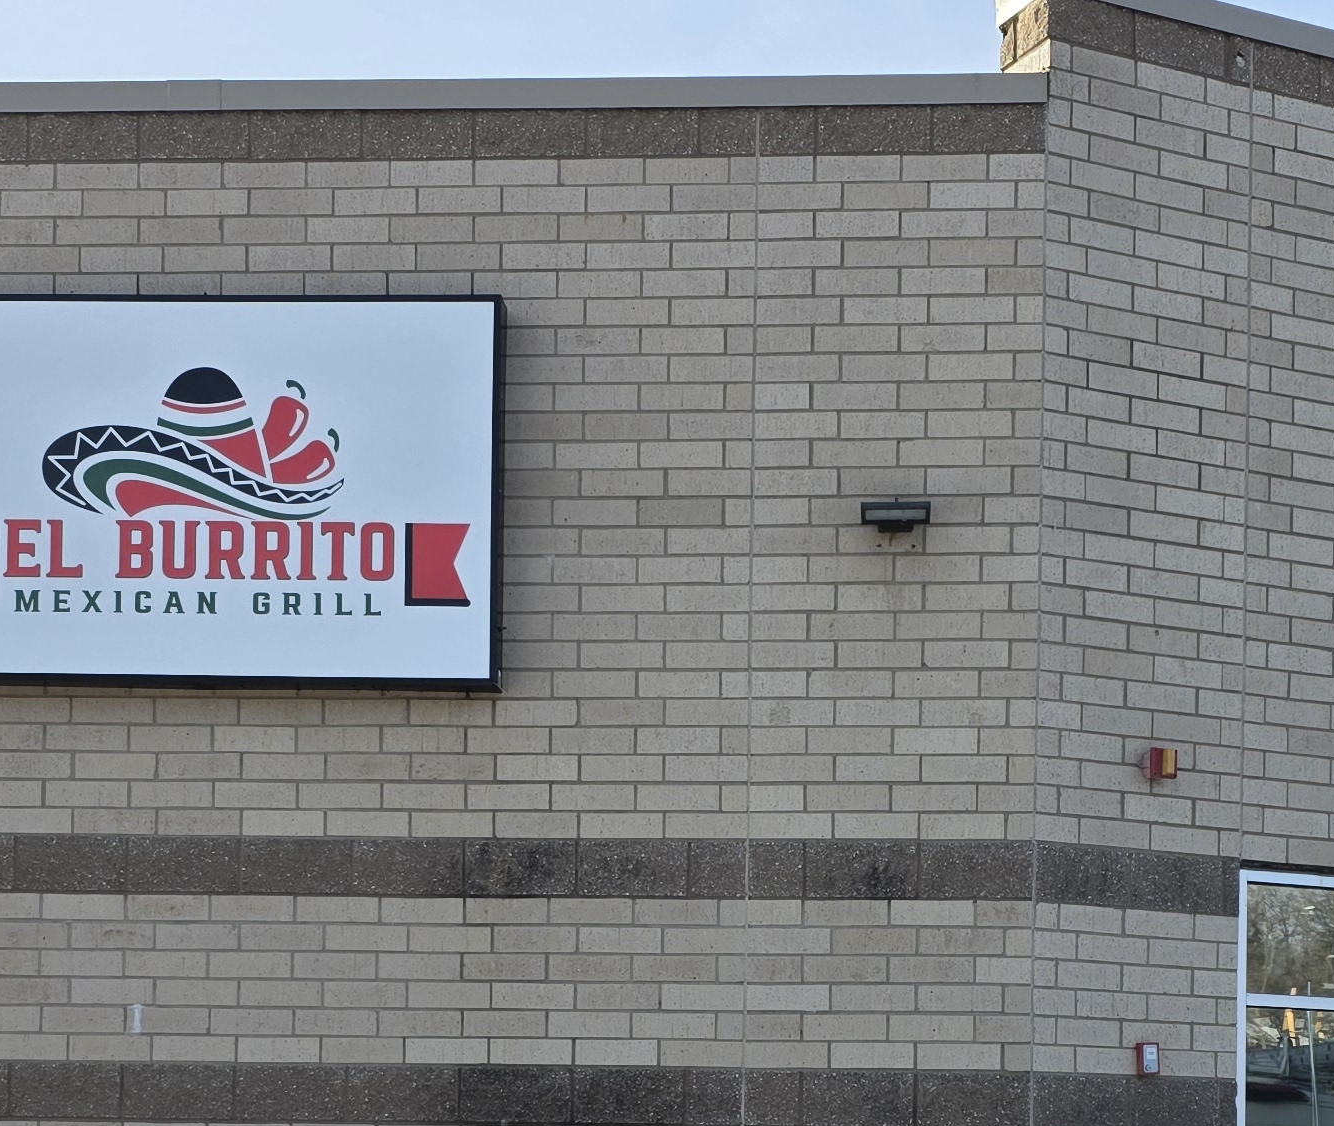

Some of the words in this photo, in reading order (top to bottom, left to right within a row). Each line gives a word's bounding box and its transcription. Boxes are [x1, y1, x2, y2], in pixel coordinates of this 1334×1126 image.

[3, 518, 83, 578] EL
[114, 519, 395, 582] BURRITO
[13, 589, 218, 615] MEXICAN
[252, 591, 382, 617] GRILL
